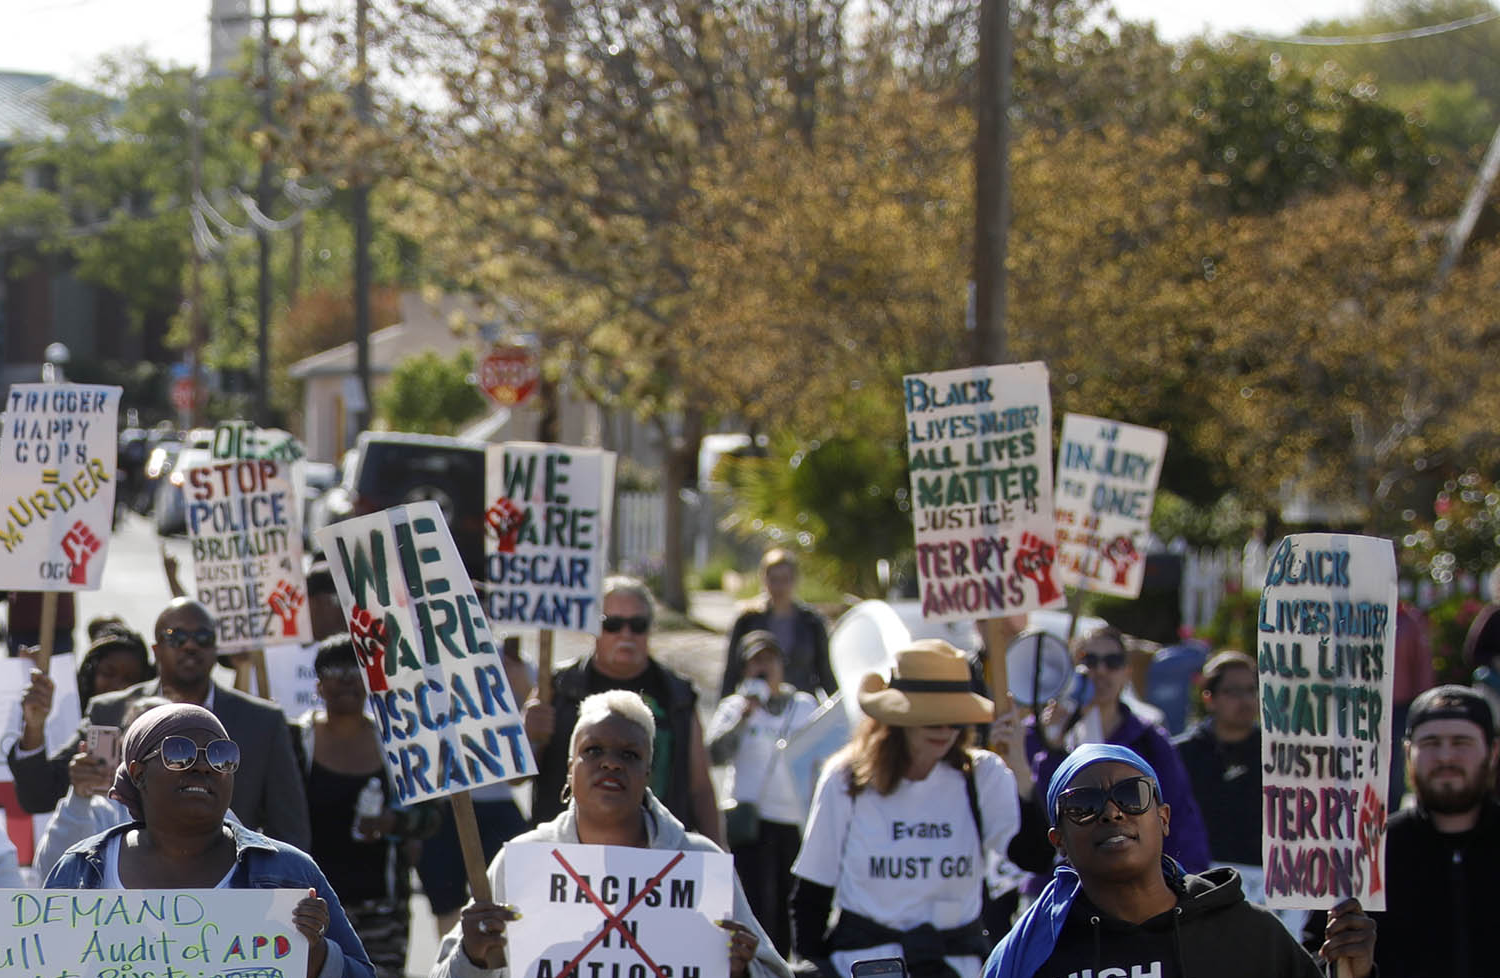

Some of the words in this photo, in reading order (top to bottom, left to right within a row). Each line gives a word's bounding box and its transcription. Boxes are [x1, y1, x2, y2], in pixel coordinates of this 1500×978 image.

[11, 391, 108, 414] TRIGGER
[13, 419, 90, 441] HAPPY
[908, 415, 977, 443] LIVES
[16, 443, 88, 464] COPS
[910, 446, 960, 470] ALL
[967, 432, 1036, 464] LIVES
[190, 459, 277, 500] STOP
[503, 453, 572, 502] WE
[917, 464, 1039, 509] MATTER
[190, 492, 286, 535] POLICE
[519, 506, 596, 551] ARE
[919, 502, 1015, 532] JUSTICE
[192, 529, 288, 561] BRUTALITY
[336, 517, 450, 611] WE
[917, 535, 1009, 578] TERRY
[196, 559, 270, 581] JUSTICE
[487, 554, 589, 588] OSCAR
[490, 595, 595, 630] GRANT
[922, 572, 1025, 618] AMONS
[1259, 595, 1331, 635] LIVES
[384, 595, 496, 677] ARE
[1259, 642, 1309, 679] ALL
[1318, 640, 1384, 681] LIVES
[1263, 683, 1382, 743] MATTER
[1264, 742, 1363, 780] JUSTICE
[892, 820, 952, 841] Evans
[1263, 785, 1359, 841] TERRY
[869, 857, 932, 880] MUST
[1265, 844, 1365, 898] AMONS
[550, 873, 695, 909] RACISM
[12, 893, 204, 929] DEMAND
[80, 930, 177, 966] Audit
[182, 923, 218, 962] of
[222, 935, 291, 963] APD
[603, 920, 638, 949] IN
